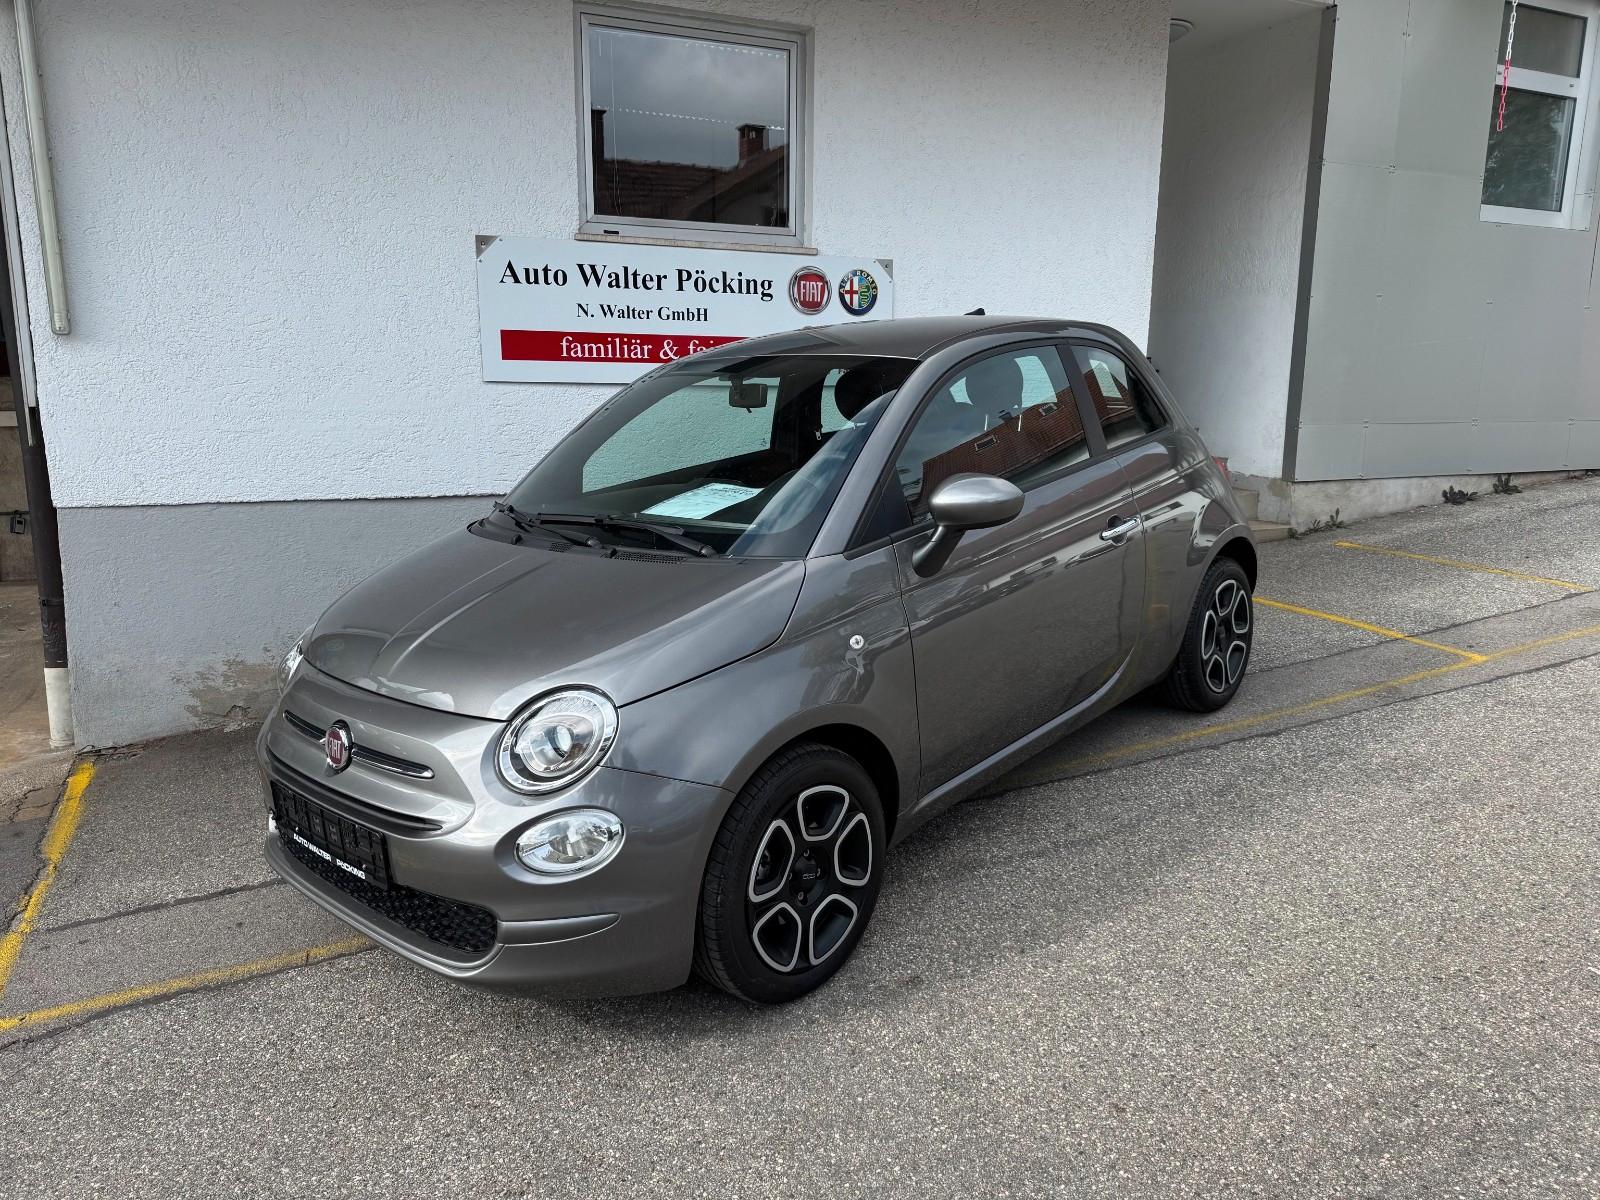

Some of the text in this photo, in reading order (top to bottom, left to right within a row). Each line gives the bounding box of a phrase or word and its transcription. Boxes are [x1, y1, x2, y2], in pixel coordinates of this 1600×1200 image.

[499, 259, 774, 302] Auto Walter Pöcking
[800, 280, 823, 302] FIAT
[856, 270, 877, 295] ROMEO
[576, 303, 709, 322] N. Walter GmbH
[560, 336, 652, 359] familiär
[659, 339, 680, 360] &
[293, 832, 309, 848] AUTO
